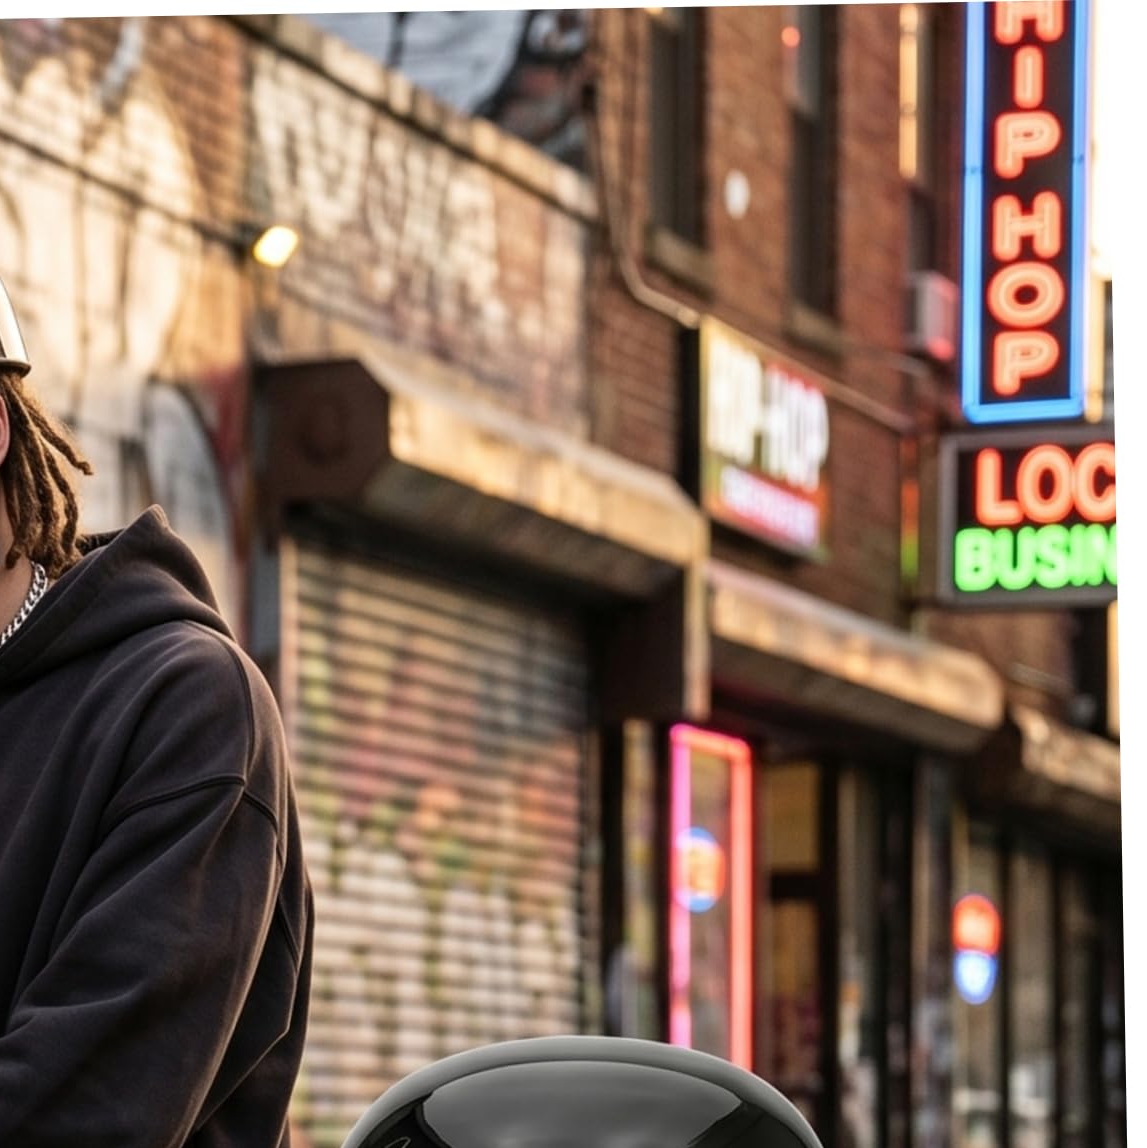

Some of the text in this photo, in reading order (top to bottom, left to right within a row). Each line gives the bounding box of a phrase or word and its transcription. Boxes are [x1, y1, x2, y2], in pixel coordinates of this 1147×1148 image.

[988, 2, 1065, 395] HIP HOP
[975, 442, 1116, 526] LOC
